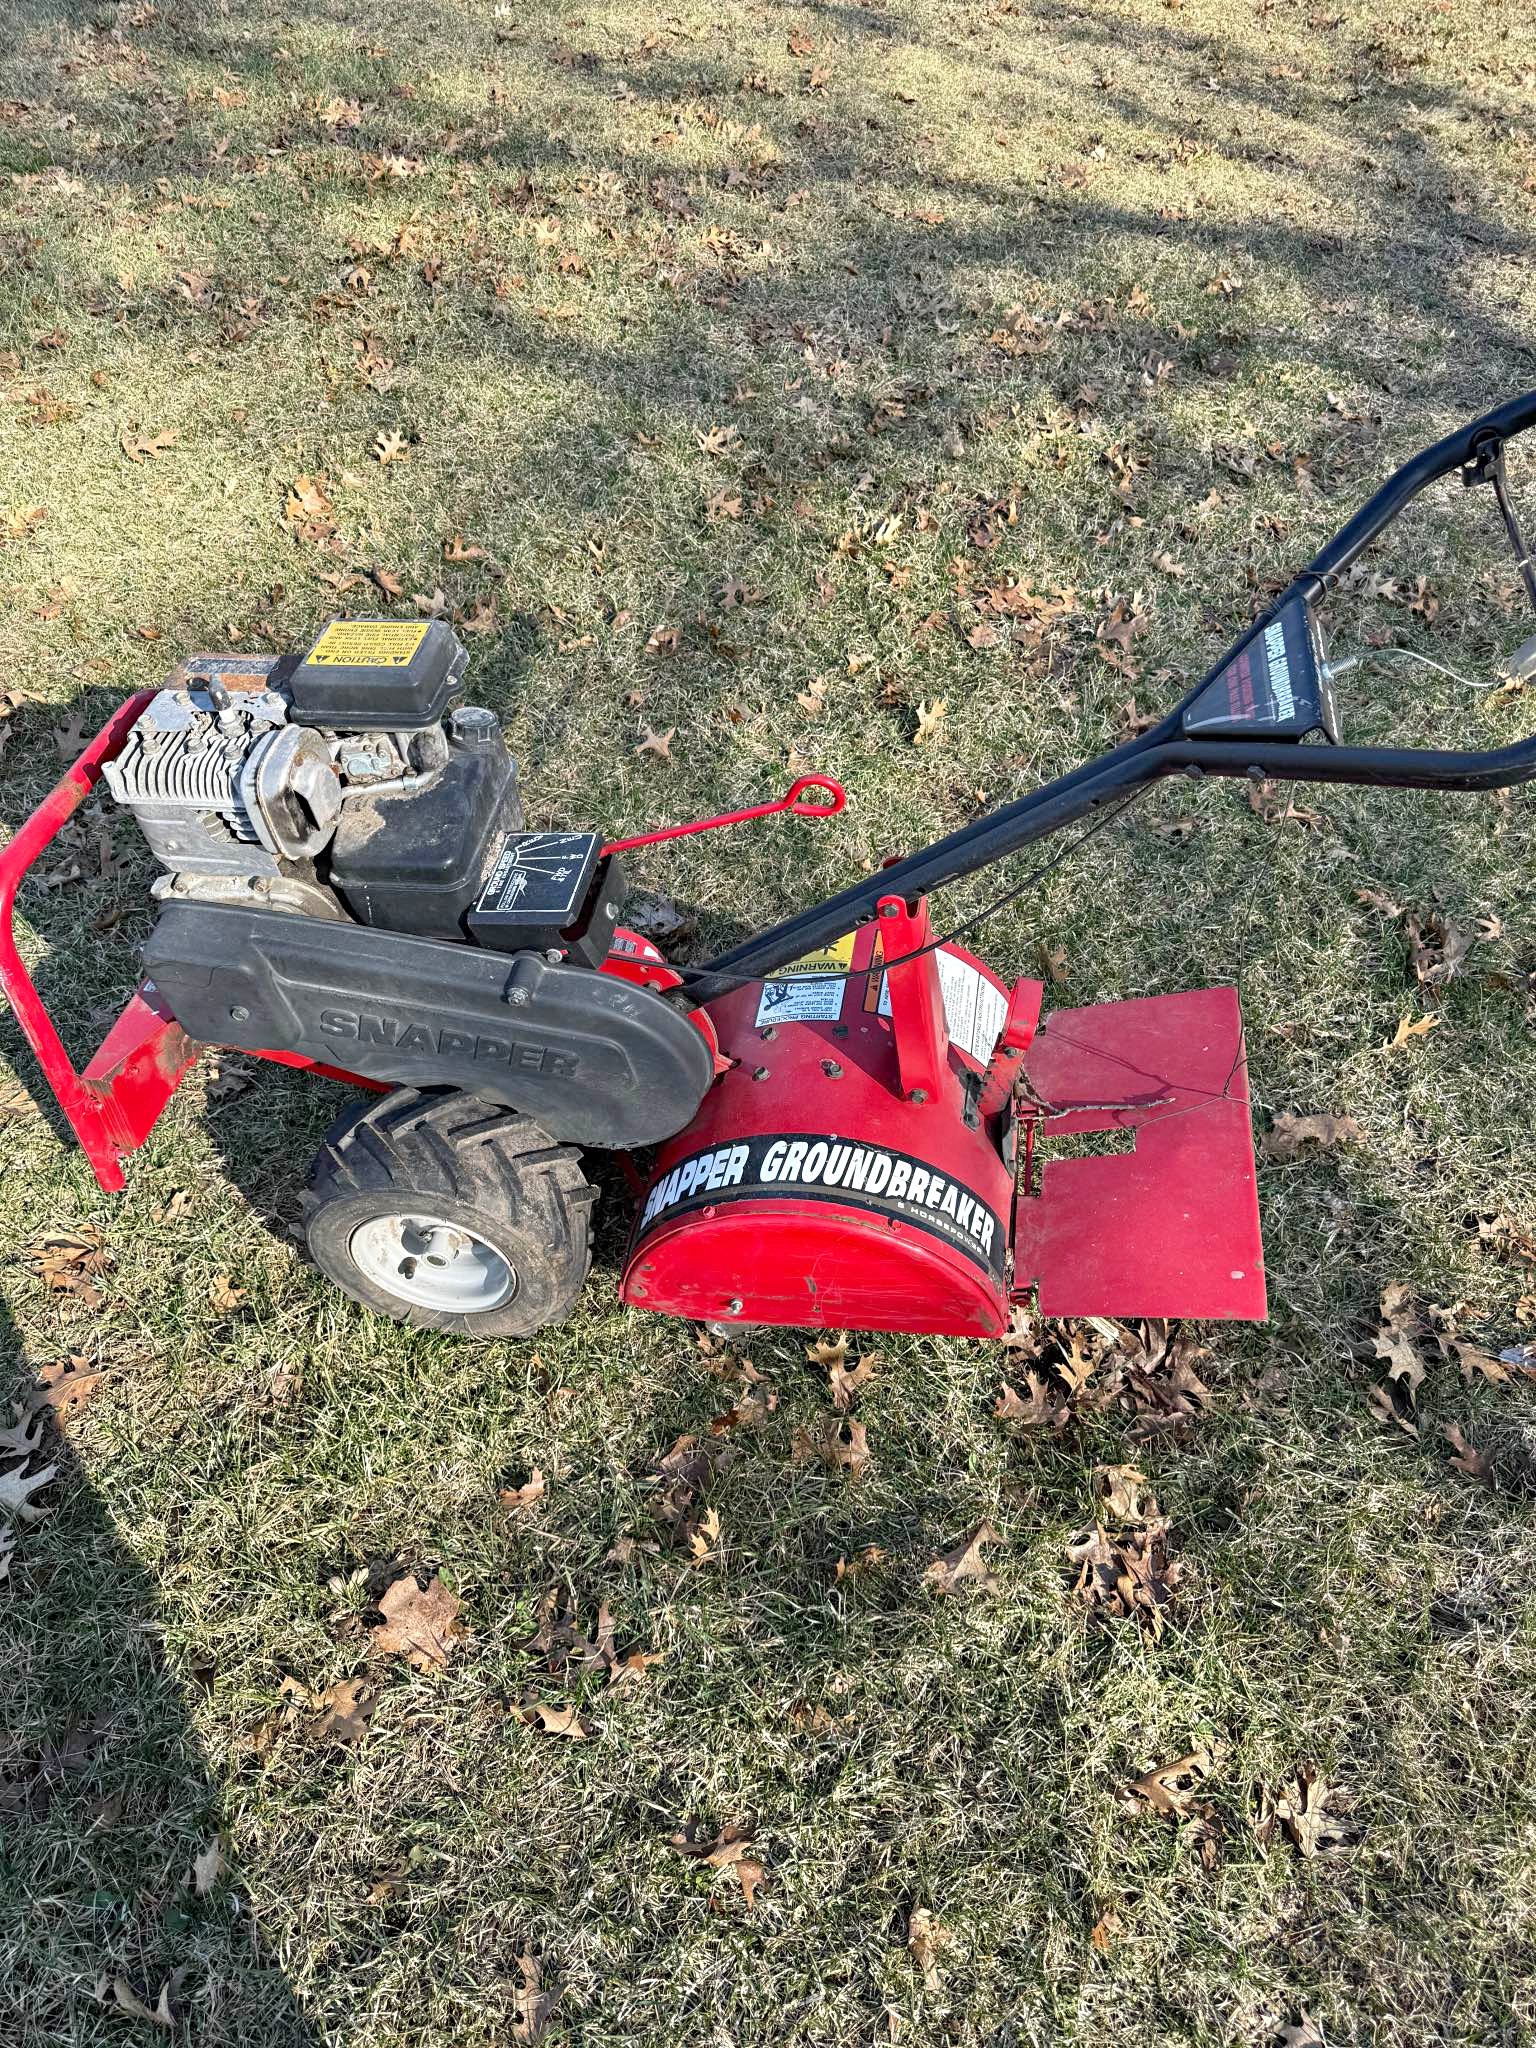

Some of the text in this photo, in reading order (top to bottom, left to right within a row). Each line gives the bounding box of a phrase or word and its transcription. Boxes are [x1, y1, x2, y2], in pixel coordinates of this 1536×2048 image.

[1264, 622, 1295, 722] SNAPPER GROUNDBREAKER
[487, 851, 511, 895] GROUND SPEED
[779, 962, 836, 974] WARNING
[871, 950, 884, 982] WANING
[320, 1008, 580, 1077] SNAPPER
[640, 1140, 995, 1257] SNAPPER GROUNDBREAKER
